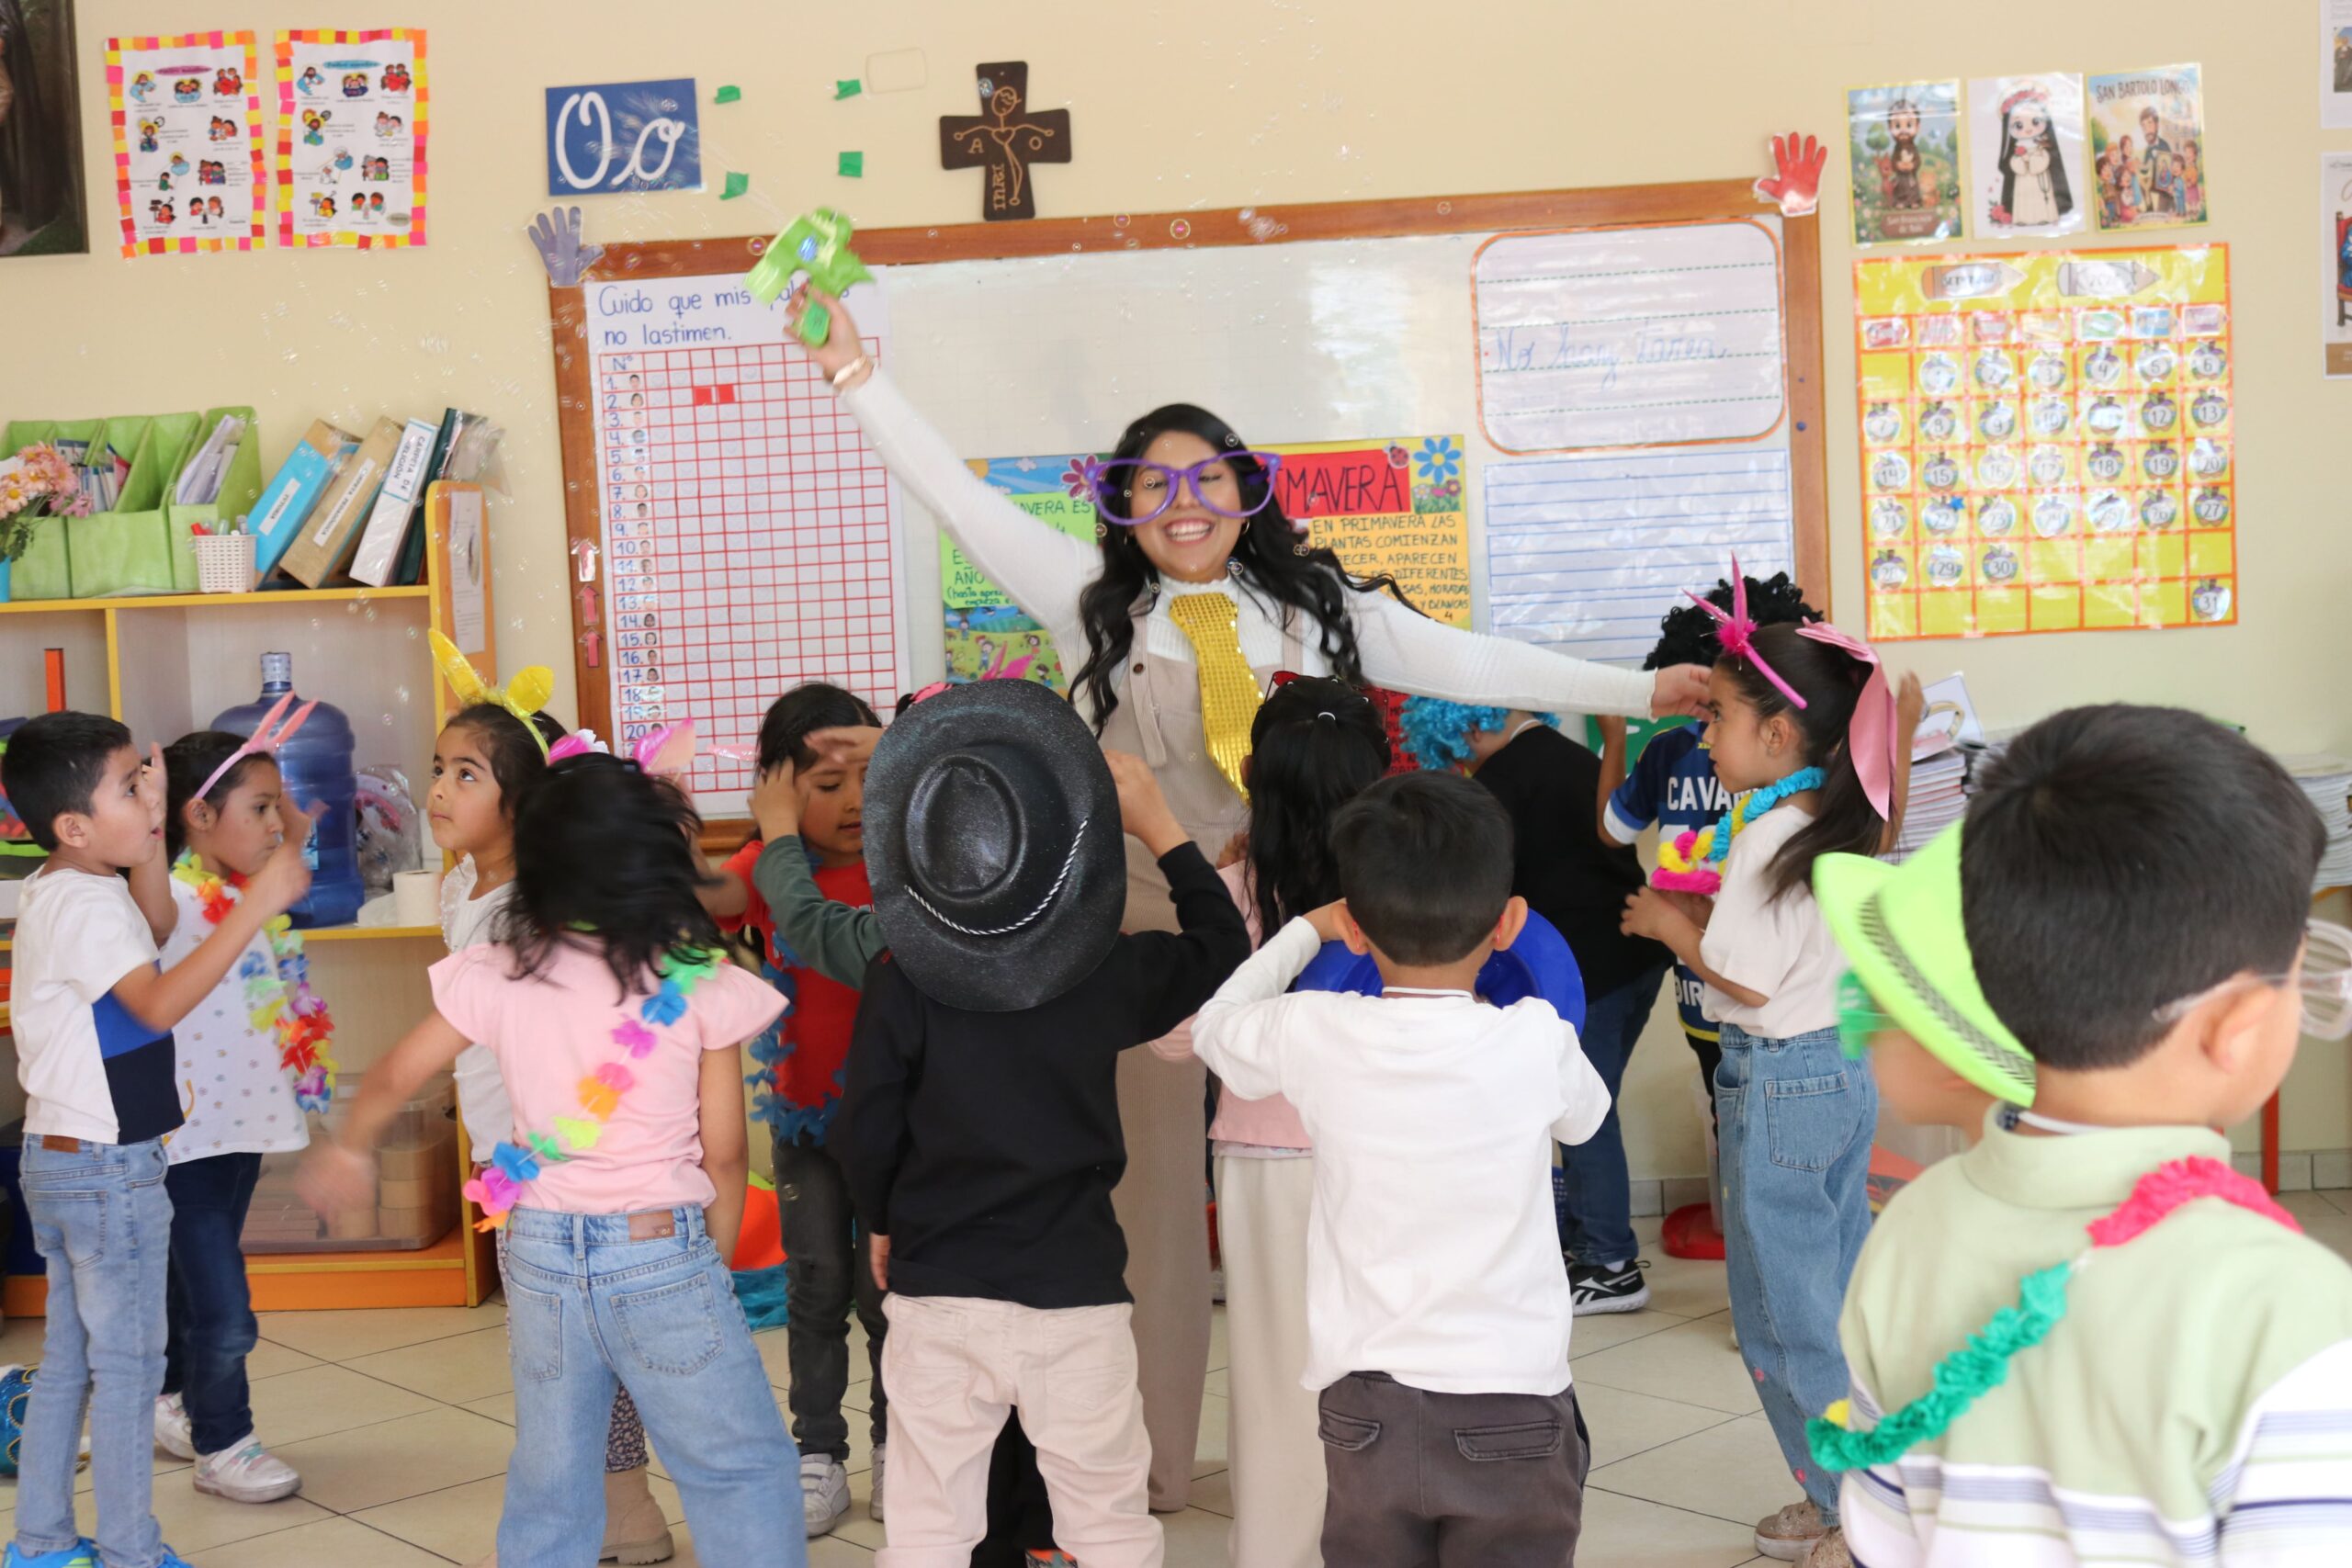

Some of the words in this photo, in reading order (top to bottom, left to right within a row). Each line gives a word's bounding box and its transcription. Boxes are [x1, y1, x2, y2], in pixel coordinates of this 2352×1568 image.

[2097, 85, 2116, 103] SAN
[2118, 80, 2157, 99] BARTOLO
[599, 285, 653, 316] Cuido
[669, 293, 702, 319] que
[715, 286, 751, 307] mis
[605, 329, 627, 345] no
[643, 322, 731, 345] lastimen.
[1497, 327, 1535, 371] No
[1552, 323, 1620, 392] hay
[2098, 364, 2109, 378] 4
[2151, 360, 2161, 375] 5
[2203, 357, 2212, 373] 6
[1934, 417, 1943, 433] 8
[1995, 418, 2003, 433] 9
[2152, 410, 2167, 424] 12
[2201, 404, 2218, 420] 13
[392, 441, 413, 479] ELIGIÓN
[1933, 468, 1950, 485] 15
[2098, 458, 2114, 474] 18
[2153, 457, 2170, 472] 19
[1072, 500, 1091, 513] ES
[2203, 502, 2222, 517] 27
[1313, 518, 1333, 535] EN
[1340, 515, 1426, 533] PRIMAVERA
[1431, 514, 1456, 529] LAS
[1315, 535, 1372, 550] PLANTAS
[1376, 535, 1457, 548] COMIENZAN
[1387, 552, 1457, 565] APARECEN
[1937, 560, 1955, 576] 29
[1992, 559, 2010, 575] 30
[955, 566, 985, 585] AÑO
[1395, 567, 1468, 581] DIFERENTES
[2202, 595, 2219, 611] 31
